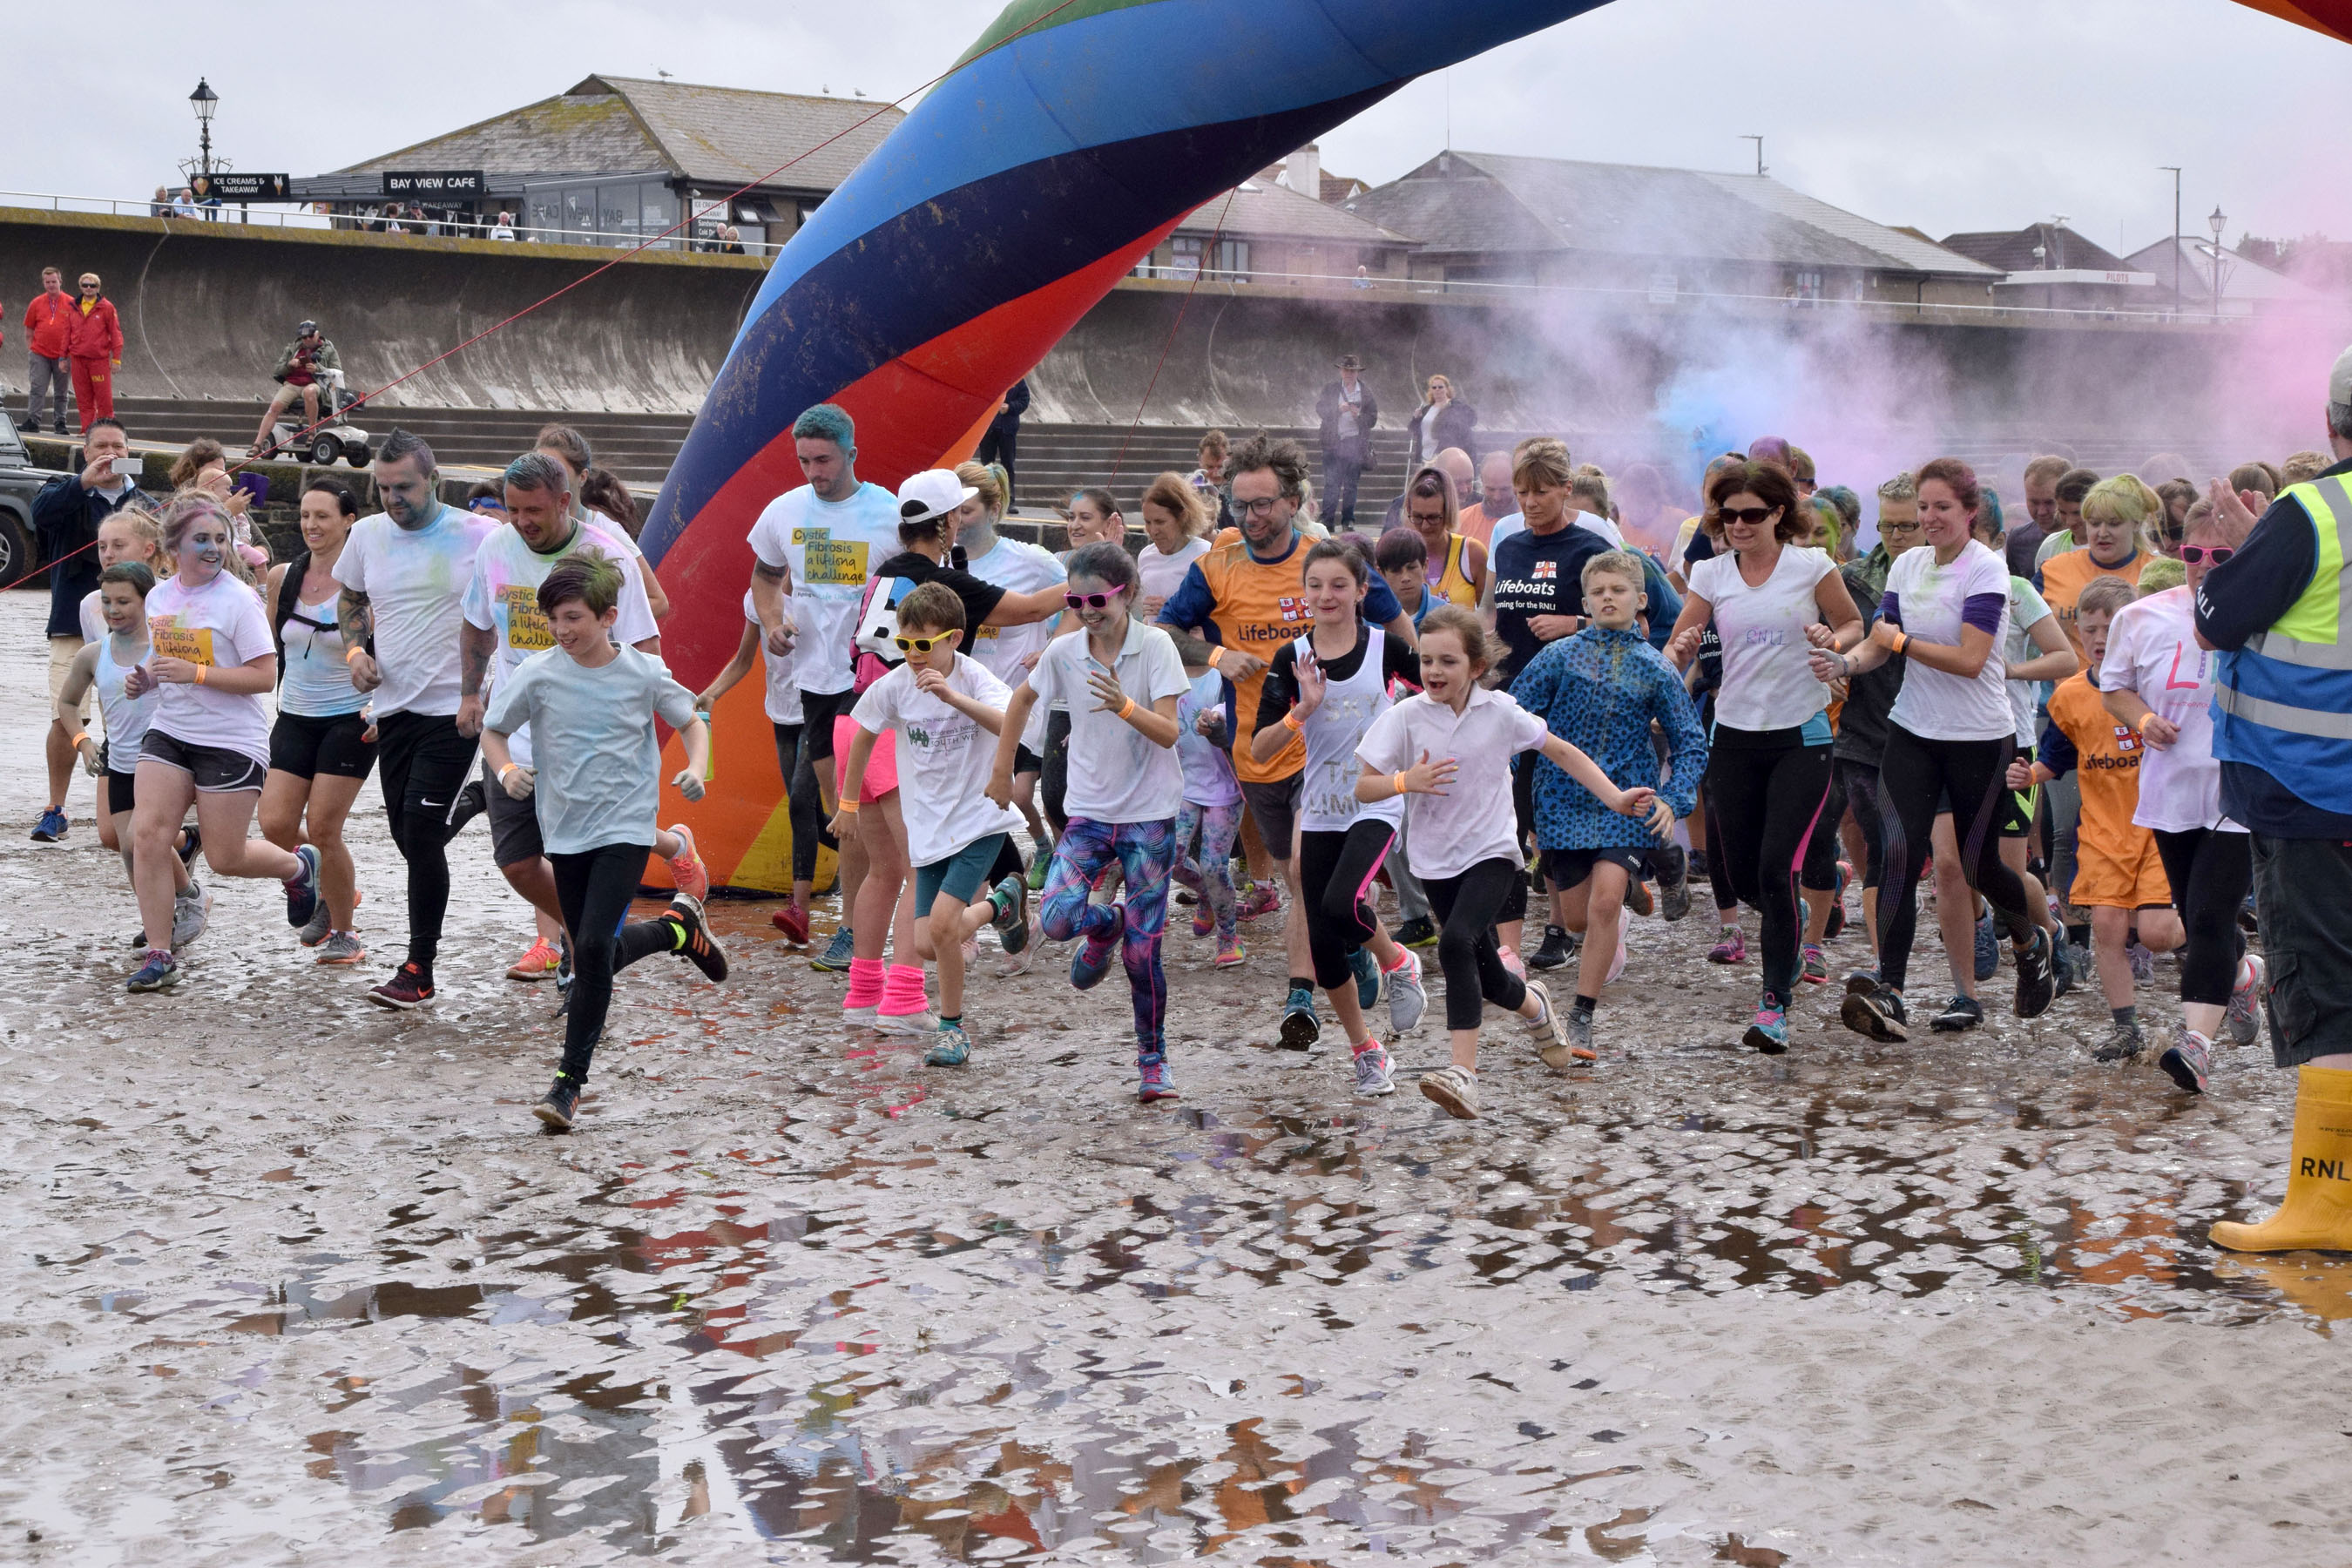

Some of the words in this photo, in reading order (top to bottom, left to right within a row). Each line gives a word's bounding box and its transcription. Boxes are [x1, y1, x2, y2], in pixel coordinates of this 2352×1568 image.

[390, 179, 411, 189] BAY
[415, 178, 443, 188] VIEW
[447, 177, 476, 188] CAFE
[2105, 272, 2129, 283] PILOTS
[794, 530, 828, 541] Cystic
[808, 541, 852, 553] Fibrosis
[816, 553, 856, 571] lifelong
[807, 568, 864, 586] challenge
[497, 586, 534, 601] Cystic
[1494, 579, 1556, 596] Lifeboats
[2196, 585, 2215, 620] NLI
[150, 618, 174, 628] ystic
[154, 629, 195, 641] Fibrosis
[1747, 629, 1787, 645] RNLI
[162, 641, 202, 659] lifelong
[1323, 693, 1382, 722] SKY
